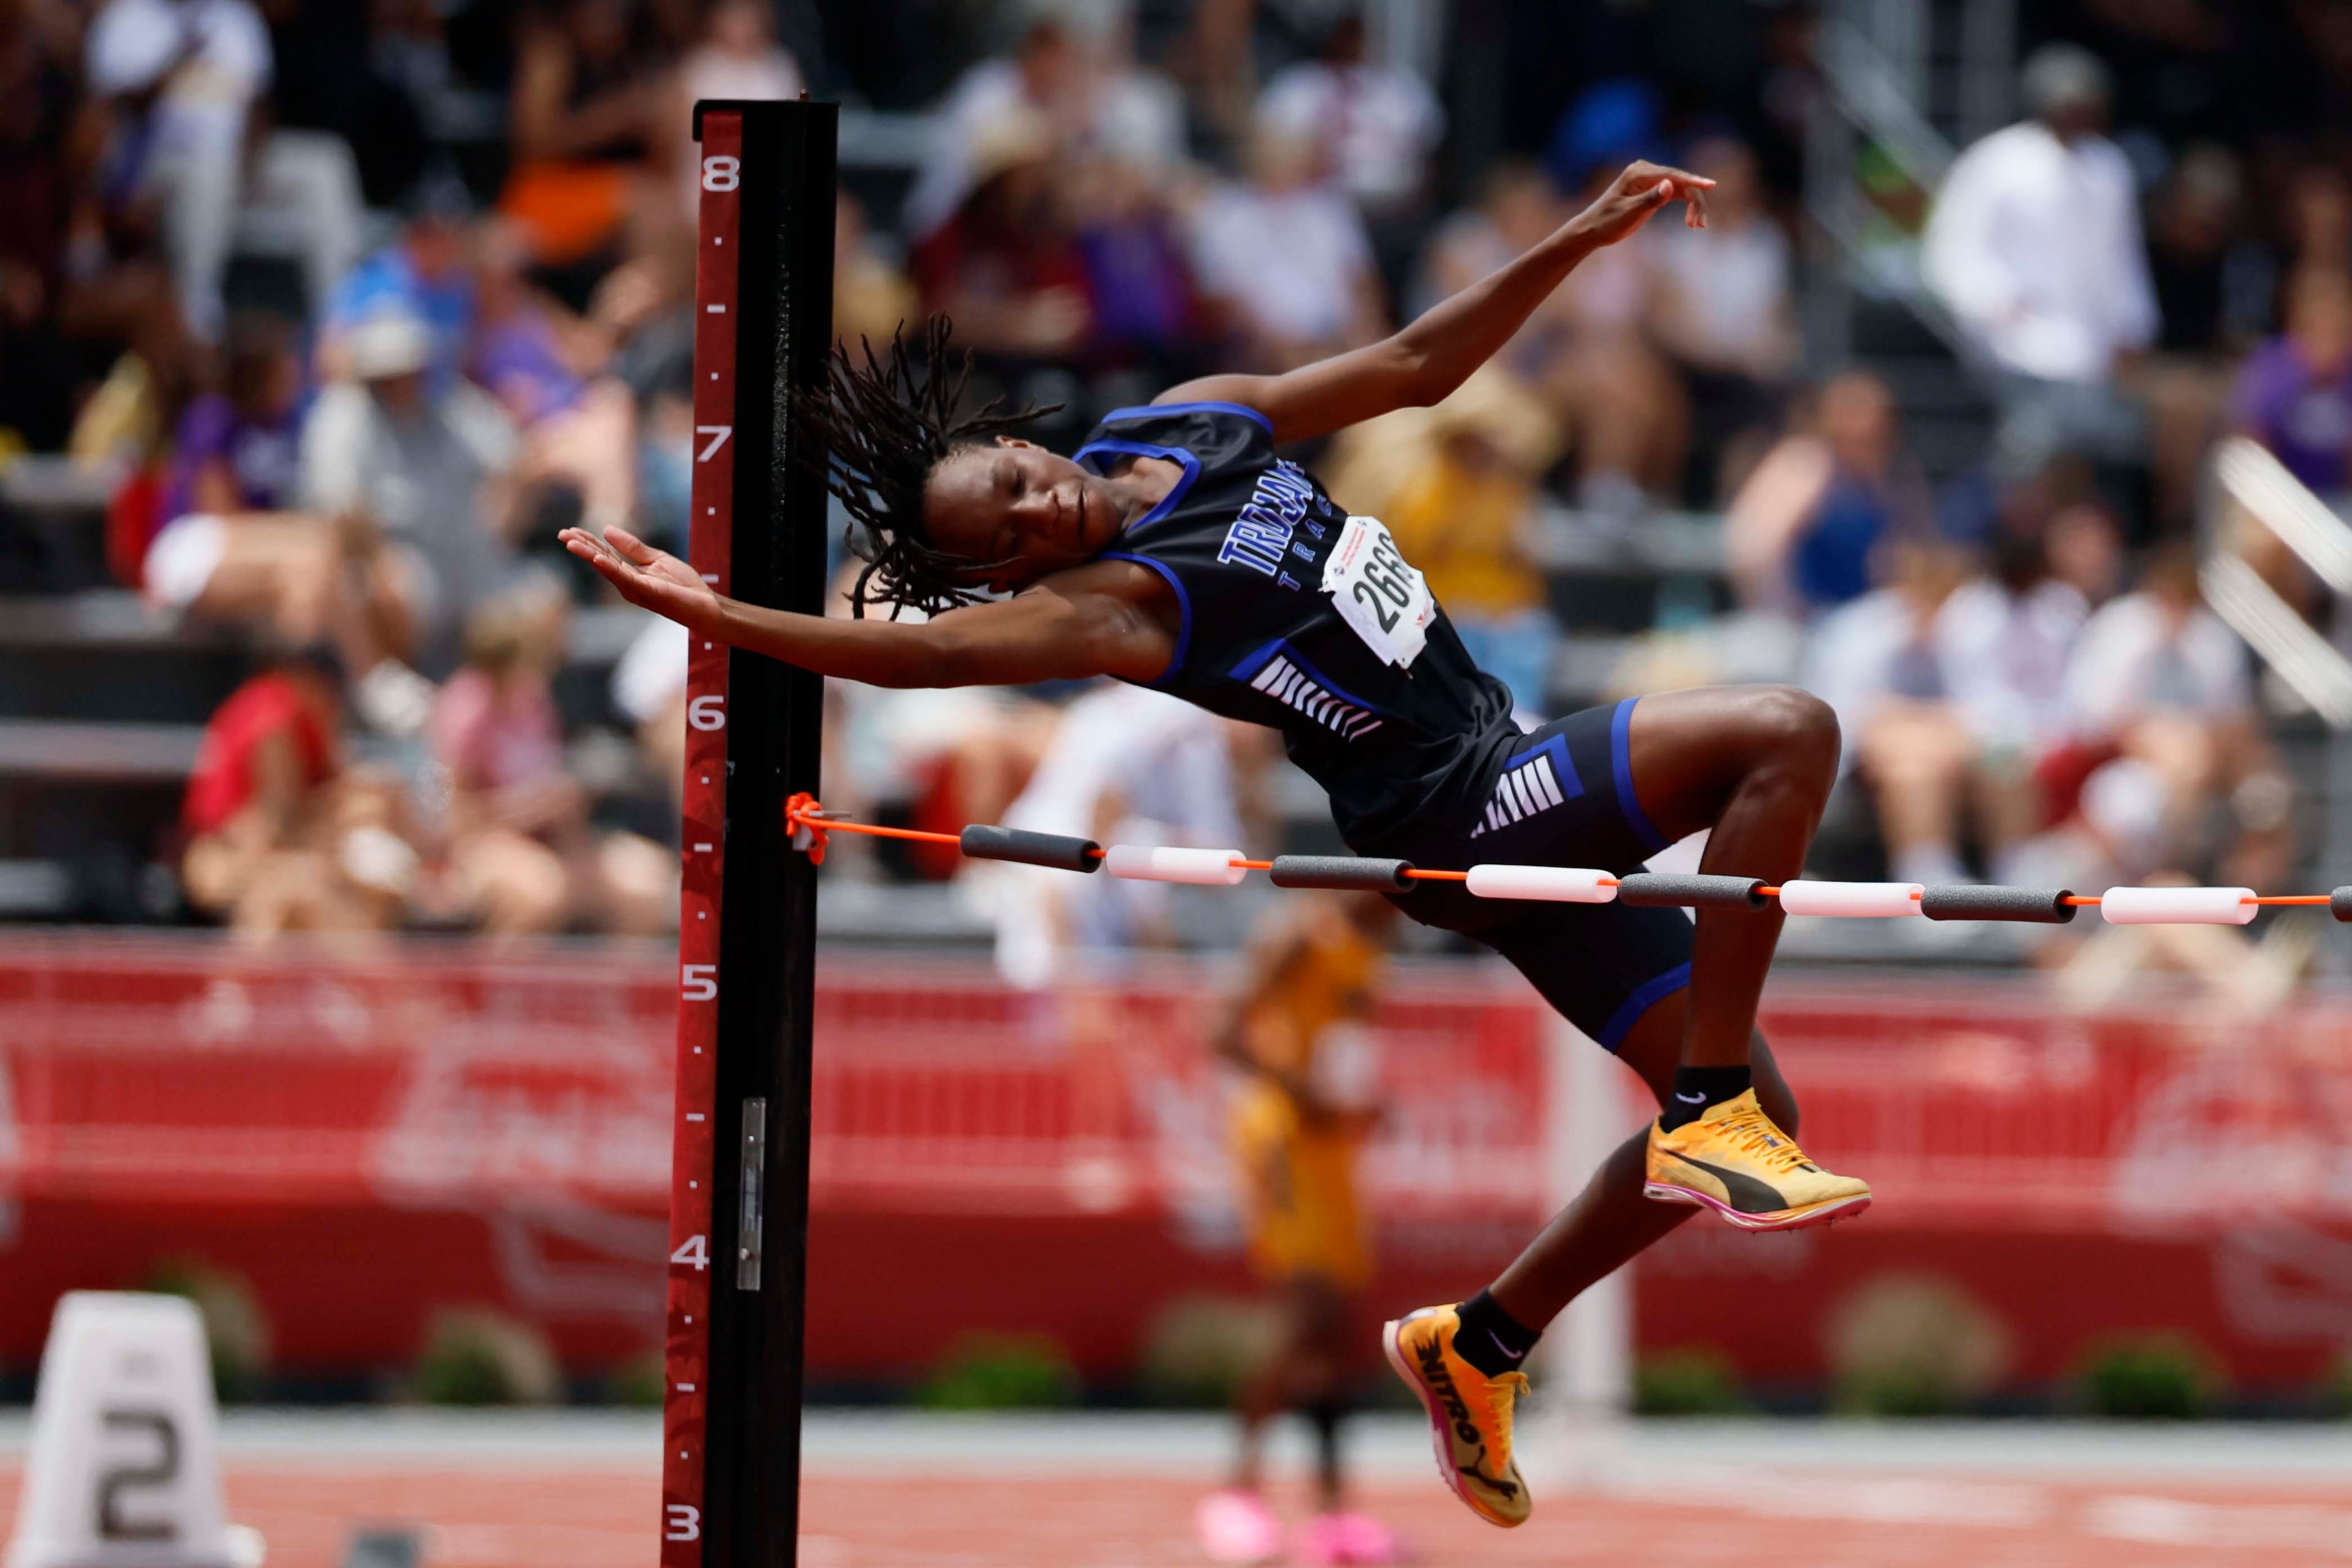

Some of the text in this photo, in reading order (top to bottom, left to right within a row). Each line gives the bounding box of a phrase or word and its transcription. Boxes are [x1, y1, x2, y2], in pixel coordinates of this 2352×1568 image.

[702, 155, 740, 192] 8
[696, 425, 732, 462] 7
[1277, 494, 1332, 592] TRAC
[688, 695, 726, 731] 6
[682, 964, 718, 1001] 5
[671, 1234, 710, 1271] 4
[1412, 1327, 1480, 1444] NITRO
[96, 1411, 182, 1540] 2
[666, 1504, 700, 1541] 3
